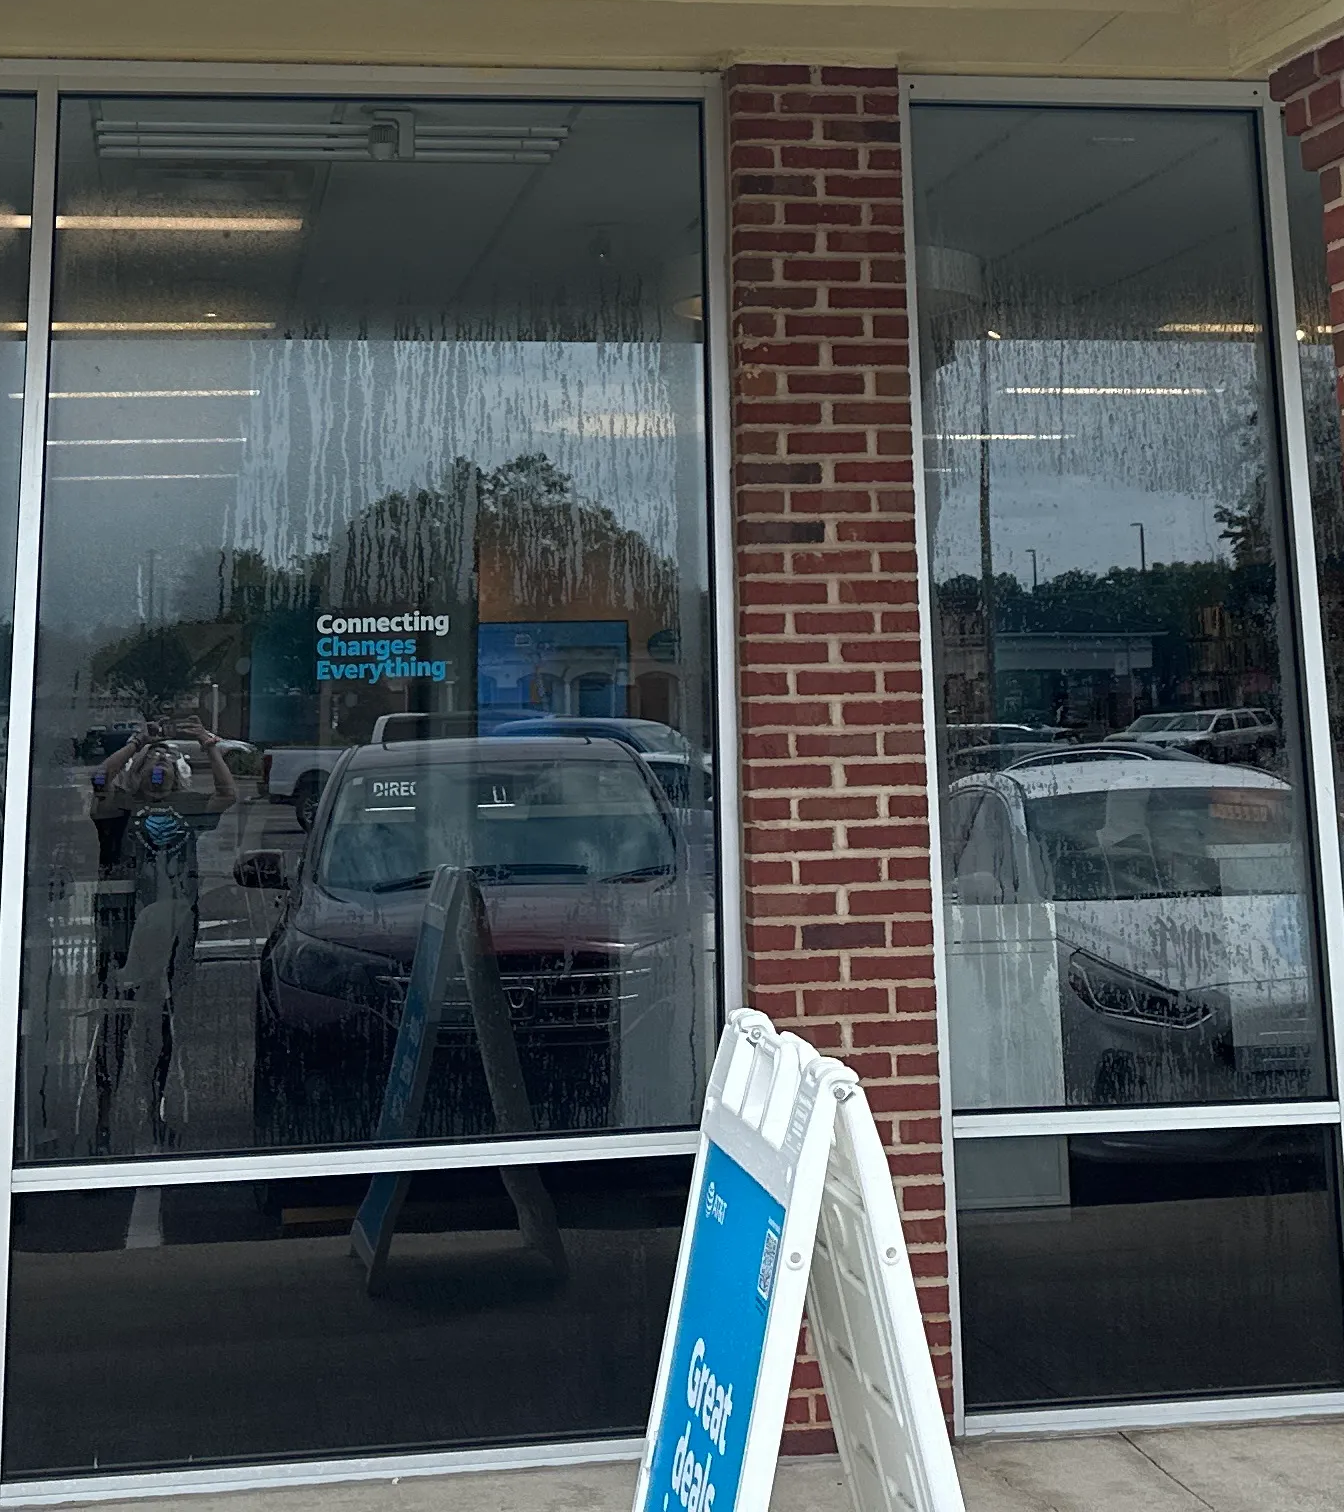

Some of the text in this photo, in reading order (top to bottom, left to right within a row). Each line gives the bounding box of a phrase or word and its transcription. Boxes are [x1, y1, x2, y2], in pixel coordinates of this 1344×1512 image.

[316, 609, 450, 637] Connecting
[316, 636, 417, 660] Changes
[316, 655, 447, 685] Everything
[687, 1336, 734, 1457] Great
